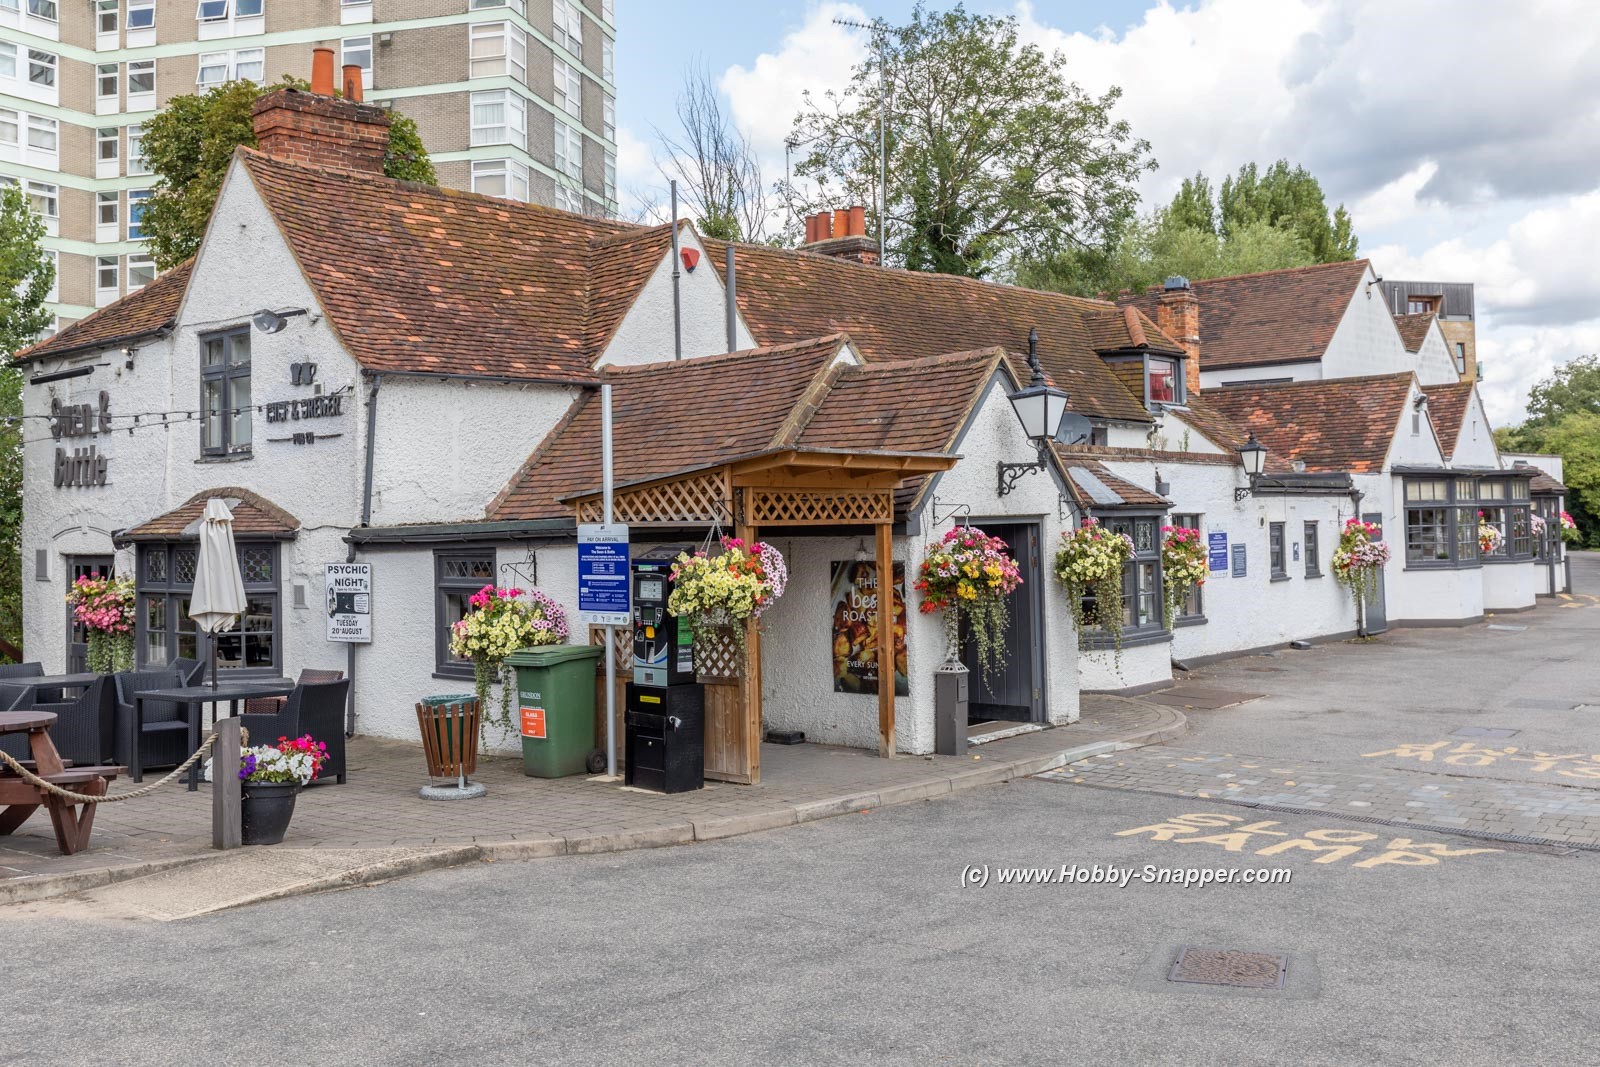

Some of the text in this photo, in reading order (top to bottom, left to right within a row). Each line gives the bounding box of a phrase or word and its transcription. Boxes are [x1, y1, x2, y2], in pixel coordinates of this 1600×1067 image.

[51, 390, 112, 440] Swan &
[291, 400, 300, 420] &
[301, 396, 343, 419] BREWER
[54, 444, 108, 488] Bottle
[327, 565, 368, 575] PSYCHIC
[334, 578, 364, 587] NIGHT
[856, 577, 878, 589] THE
[851, 584, 878, 609] bes
[336, 619, 359, 627] TUESDAY
[341, 627, 363, 635] AUGUST
[846, 660, 879, 670] EVERY SUN
[1113, 820, 1440, 868] RAMP
[1166, 813, 1505, 857] SLOW
